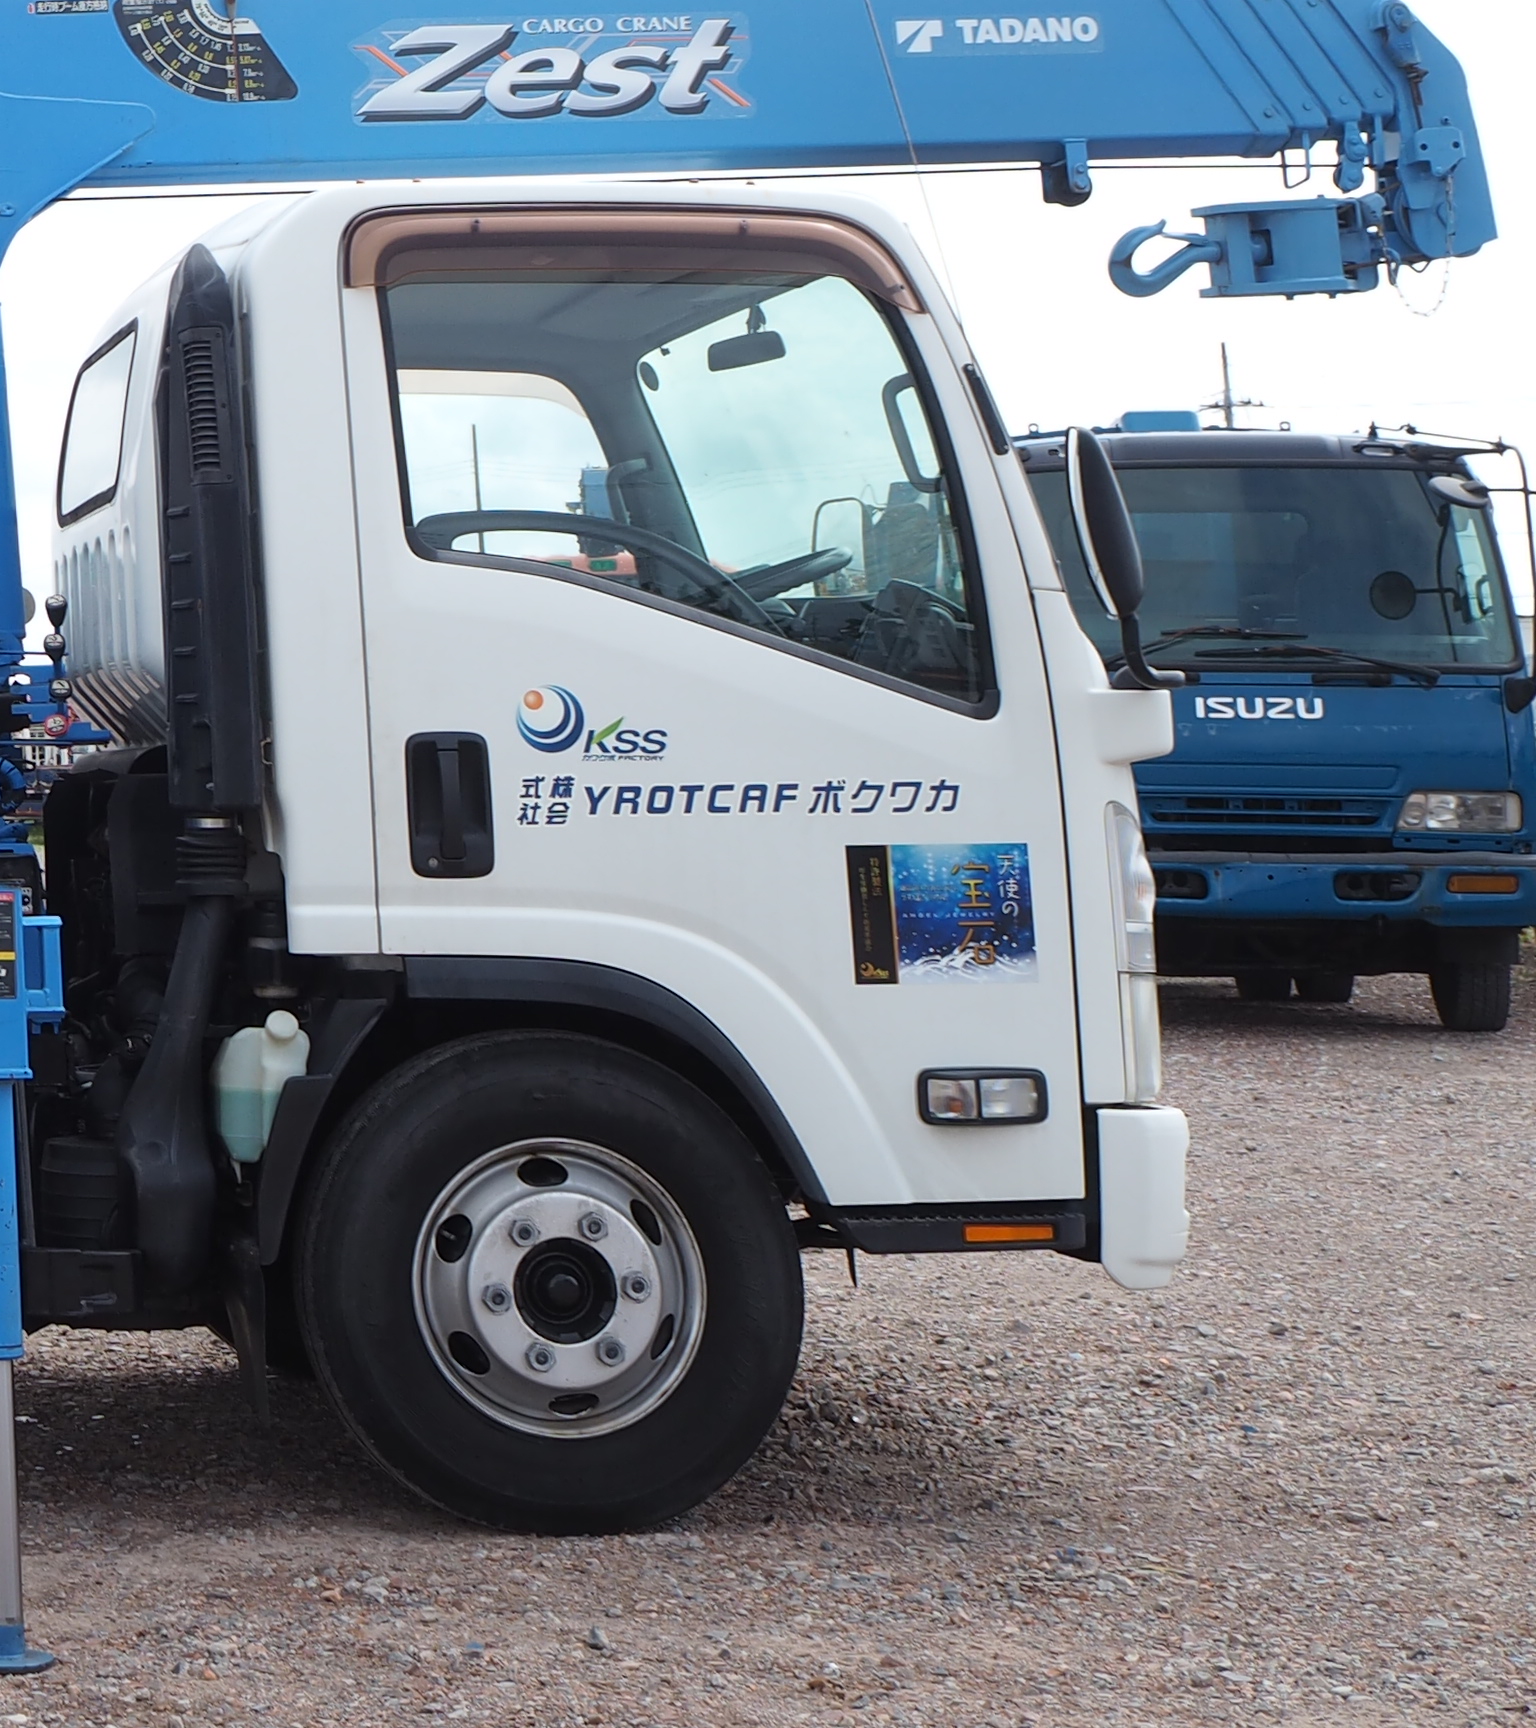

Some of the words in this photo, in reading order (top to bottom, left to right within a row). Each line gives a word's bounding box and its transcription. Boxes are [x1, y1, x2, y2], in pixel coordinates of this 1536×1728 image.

[522, 18, 604, 35] CARGO
[616, 16, 692, 32] CRANE
[955, 16, 1099, 44] TADANO
[356, 19, 732, 121] Zest
[1194, 696, 1324, 719] ISUZU
[583, 717, 668, 754] KSS
[584, 784, 800, 815] YROTCAF
[997, 854, 1021, 918] 天使の
[951, 861, 996, 965] 宝石
